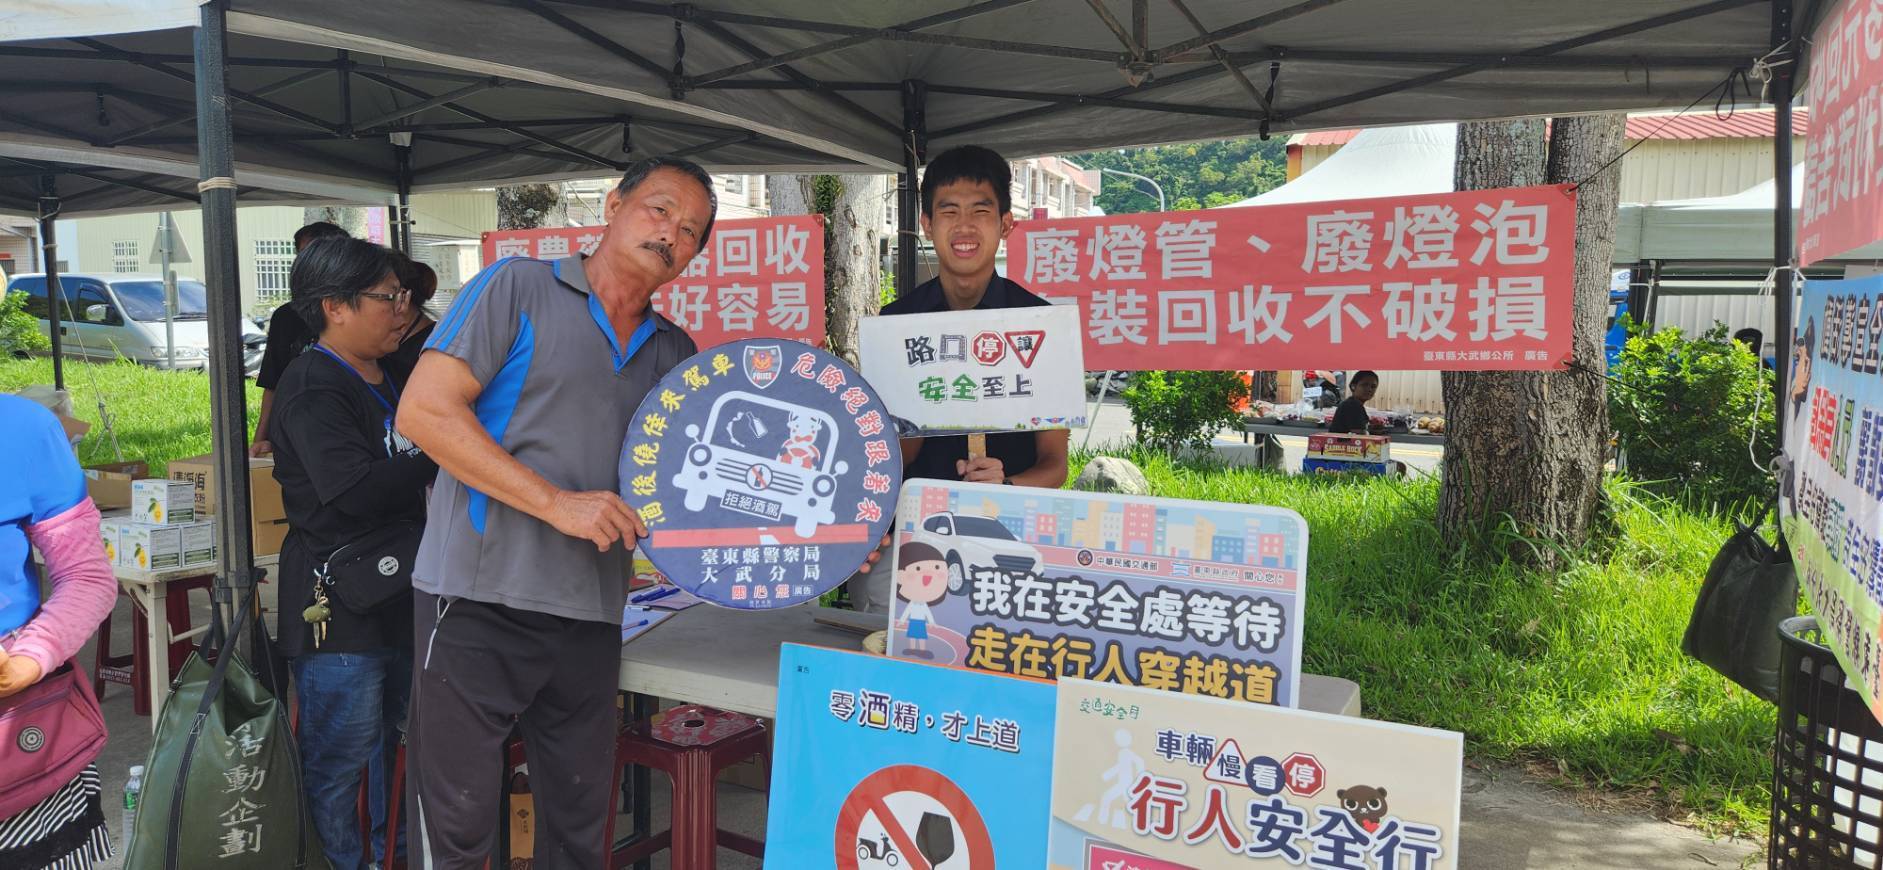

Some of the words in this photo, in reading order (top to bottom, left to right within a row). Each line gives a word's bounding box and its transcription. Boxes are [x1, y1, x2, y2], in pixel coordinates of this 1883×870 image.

[1024, 200, 1549, 285] 廢燈管、廢燈泡
[1037, 275, 1549, 346] 裝回收不破損
[905, 332, 1034, 367] 路口停讓
[1524, 349, 1548, 361] 廣告
[918, 374, 1034, 404] 安全至上
[724, 492, 781, 517] 拒絕酒駕
[701, 545, 821, 565] 臺東縣警察局
[701, 564, 821, 584] 大武分局
[1097, 556, 1158, 570] 中華民國交通部
[973, 569, 1282, 650] 我在安全處等待
[968, 627, 1279, 704] 走在行人穿越道
[1155, 729, 1319, 790] 車輛慢看停
[218, 723, 267, 858] 活動企劃
[1129, 773, 1442, 870] 行人安全行
